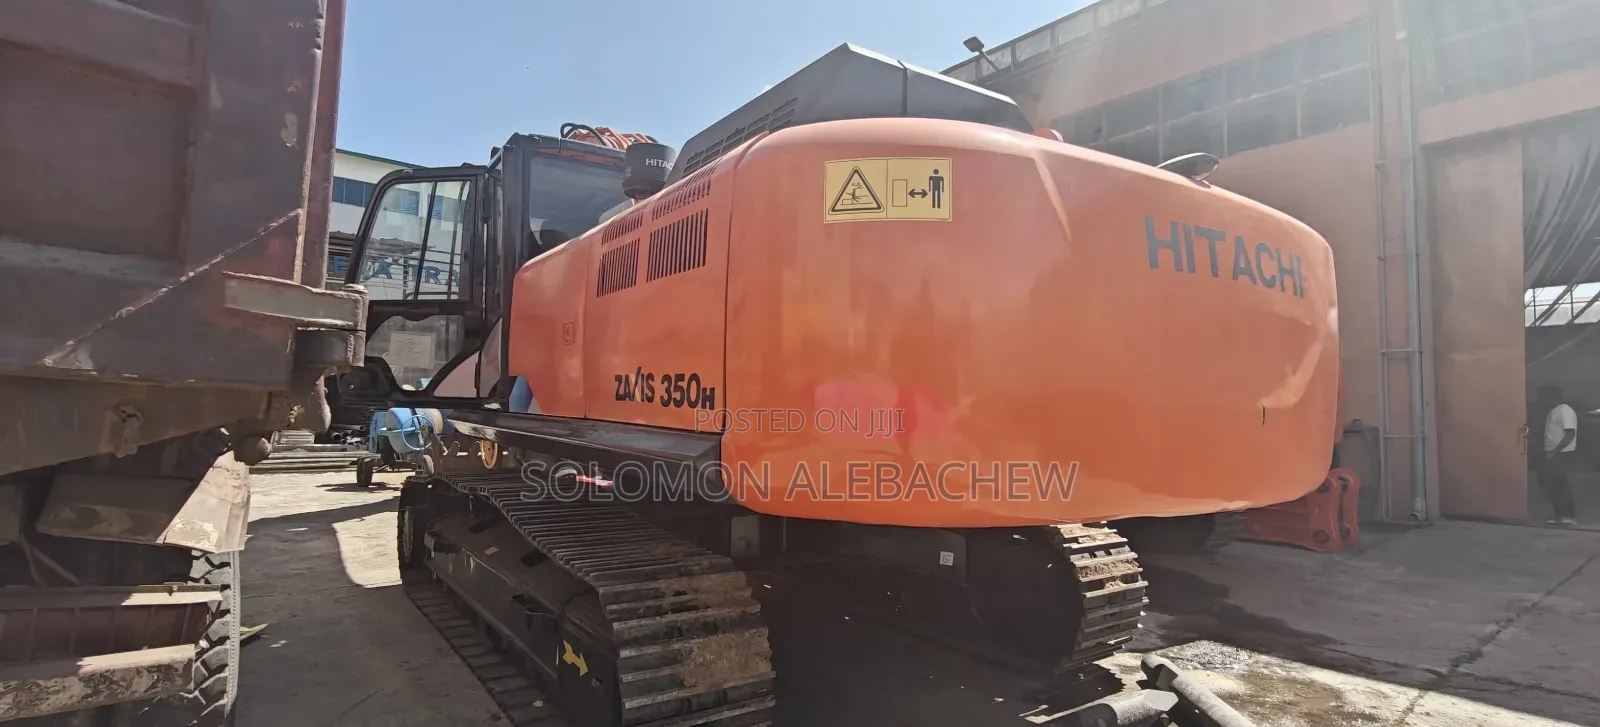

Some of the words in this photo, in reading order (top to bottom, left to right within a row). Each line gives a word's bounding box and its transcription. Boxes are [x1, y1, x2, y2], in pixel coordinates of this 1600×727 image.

[1145, 215, 1305, 299] HITACHI
[614, 366, 656, 404] ZAXIS
[659, 372, 716, 411] 350H
